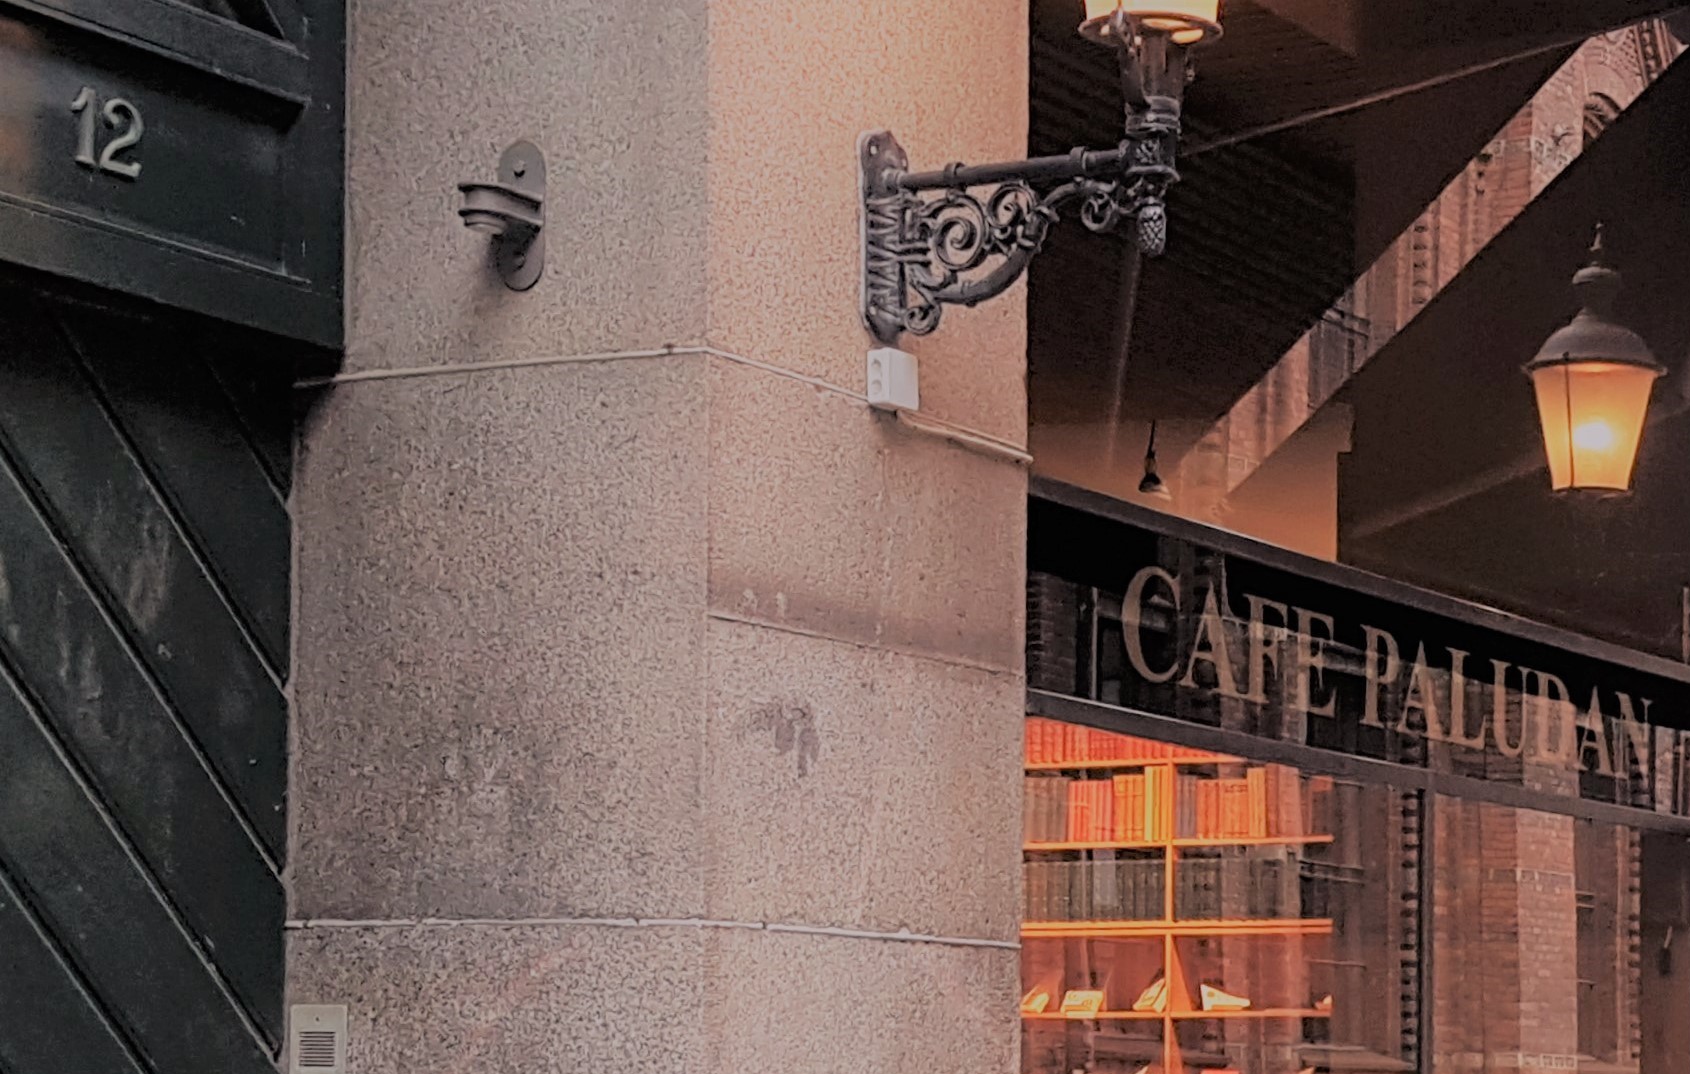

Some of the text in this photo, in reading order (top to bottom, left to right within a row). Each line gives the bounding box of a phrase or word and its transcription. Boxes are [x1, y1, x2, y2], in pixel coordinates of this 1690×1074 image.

[71, 86, 144, 178] 12
[1121, 565, 1653, 791] CAFE PALUDAN
